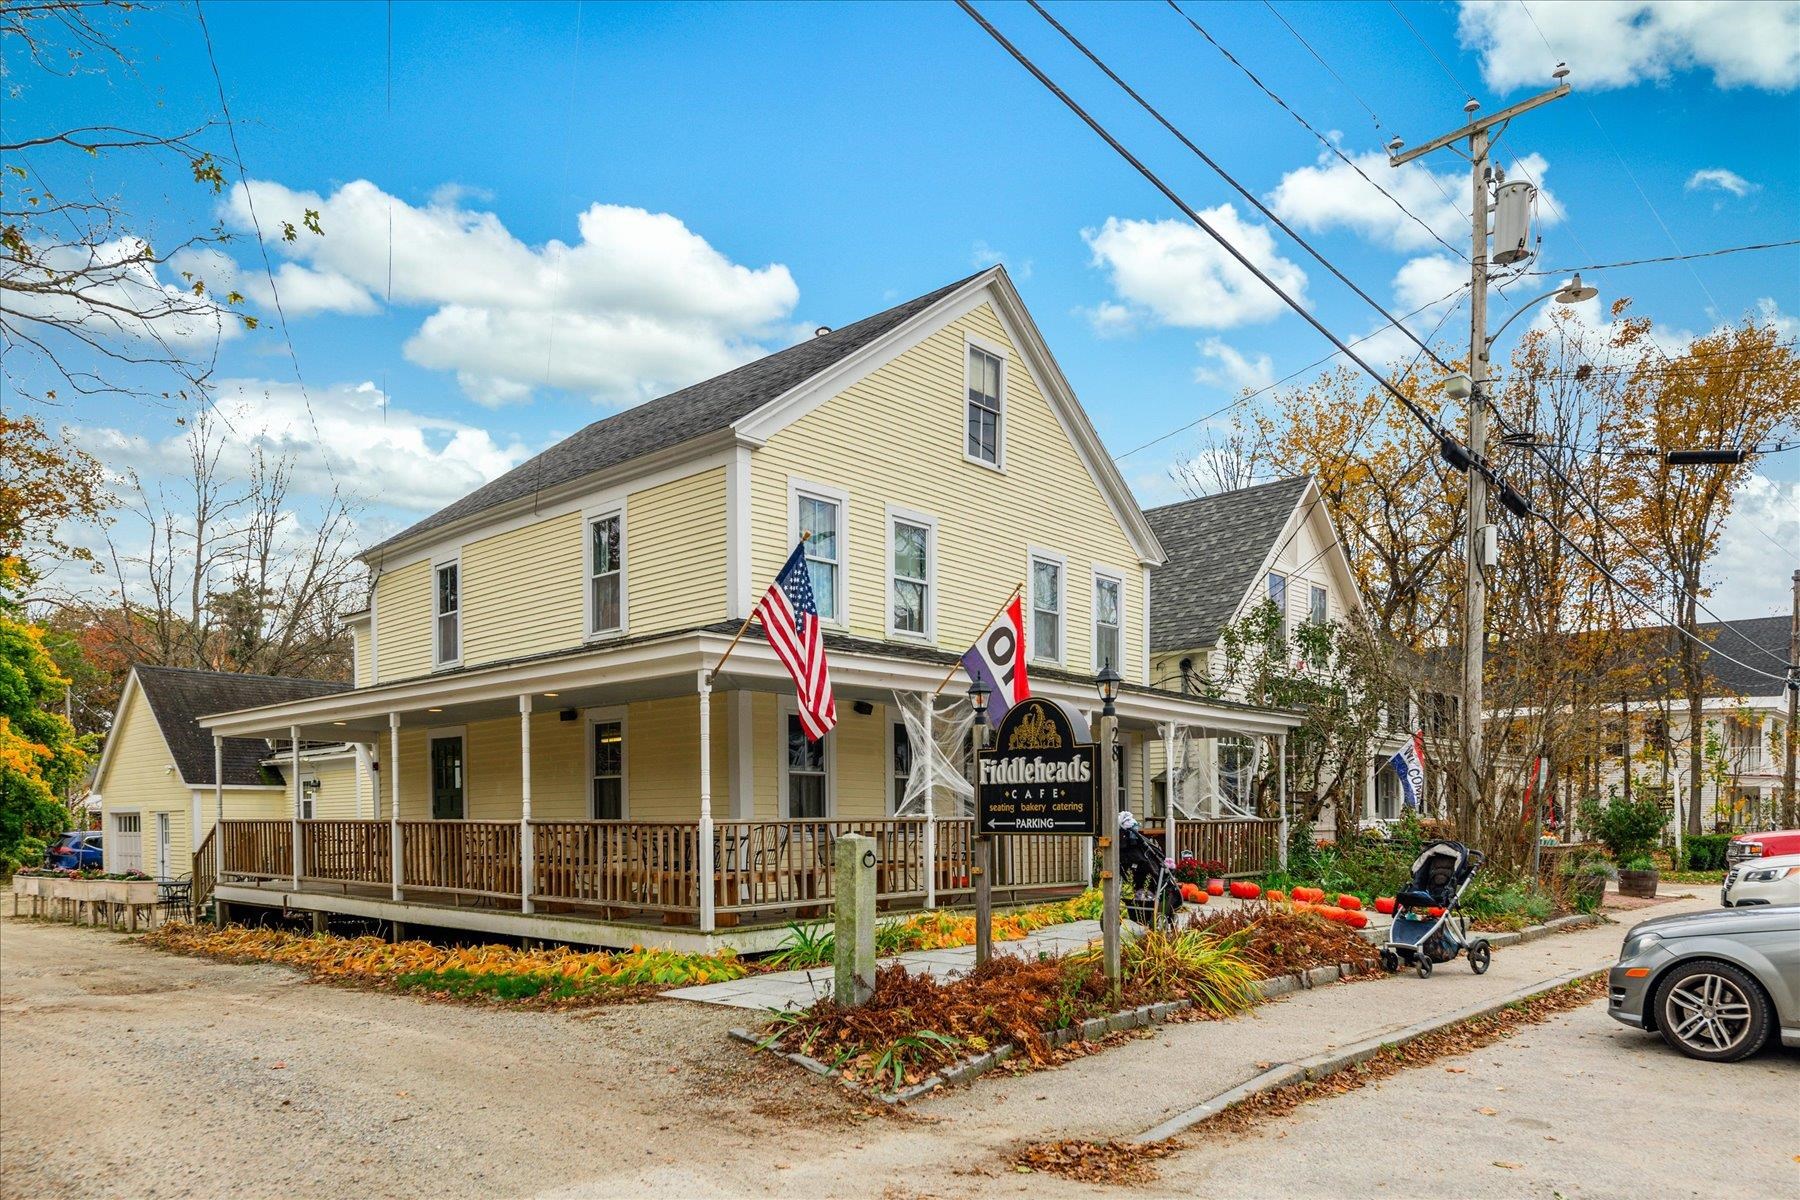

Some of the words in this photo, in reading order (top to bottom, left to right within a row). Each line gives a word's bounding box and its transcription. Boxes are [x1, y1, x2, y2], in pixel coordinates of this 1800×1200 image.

[1111, 726, 1119, 761] 28
[979, 754, 1091, 785] Fiddleheads
[1011, 788, 1058, 799] CAFE
[989, 803, 1015, 813] seating
[1020, 802, 1046, 813] bakery
[1052, 801, 1084, 812] catering
[1015, 818, 1054, 829] PARKING
